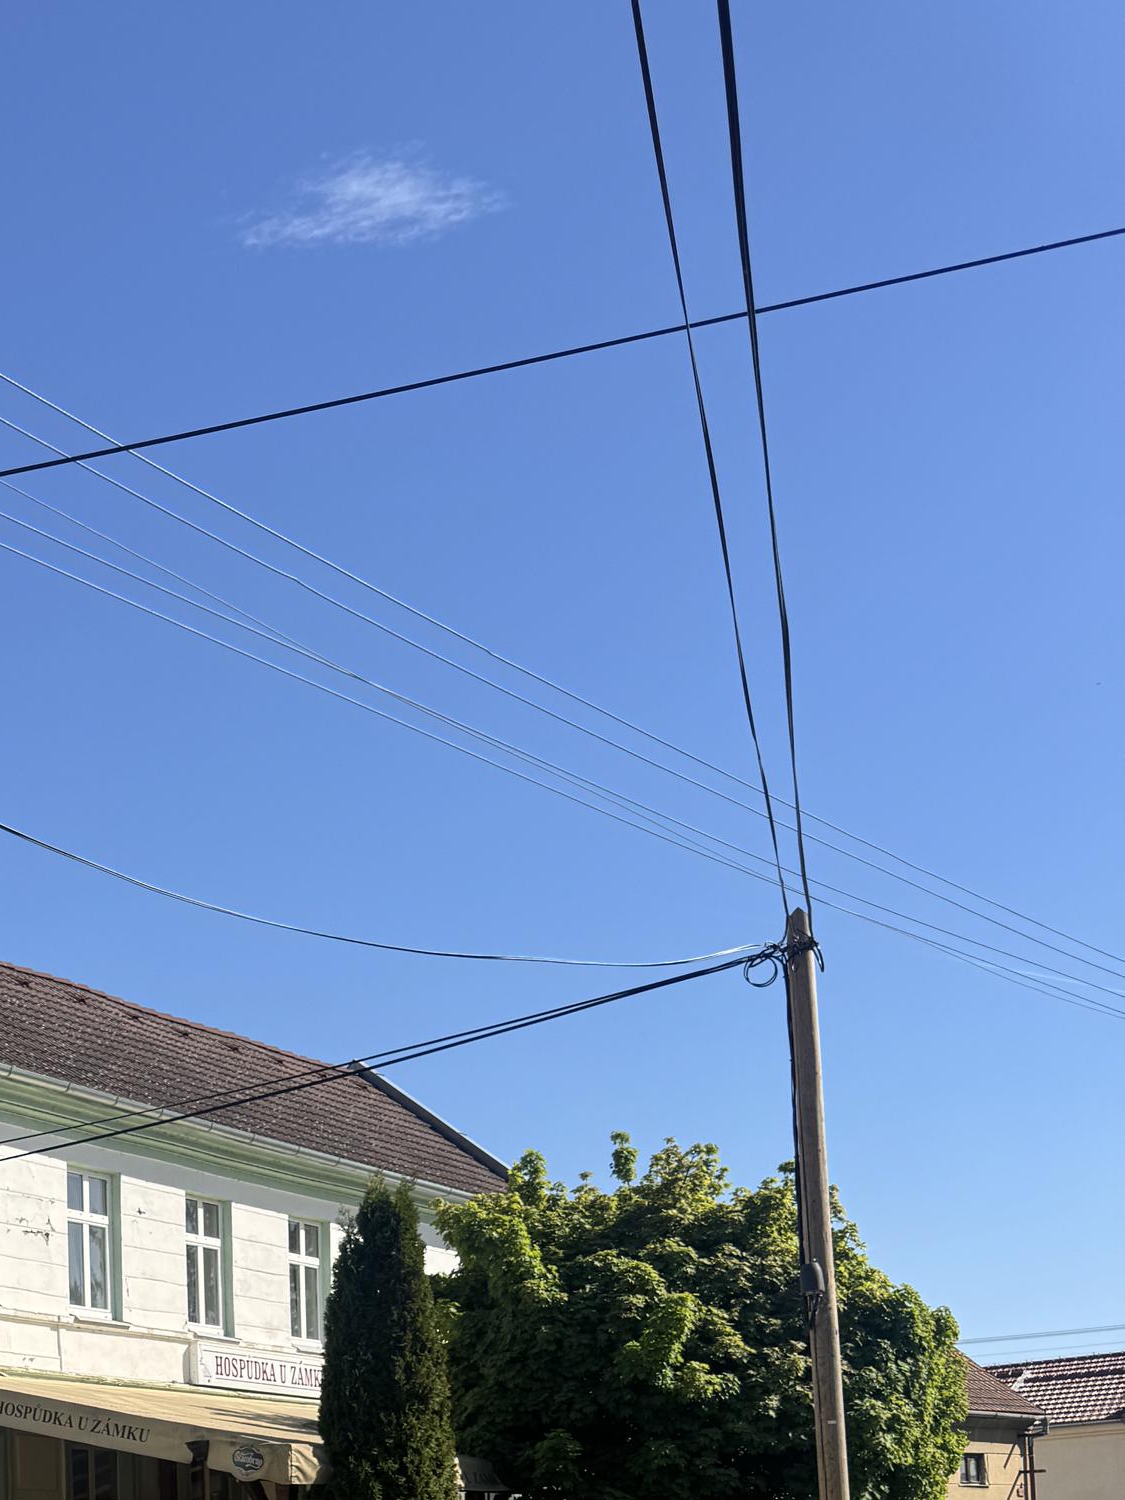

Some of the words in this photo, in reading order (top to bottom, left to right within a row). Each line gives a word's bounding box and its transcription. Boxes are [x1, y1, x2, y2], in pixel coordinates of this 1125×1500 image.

[279, 1364, 287, 1384] U
[291, 1360, 322, 1388] ZÁMK
[78, 1415, 89, 1431] U
[90, 1417, 151, 1443] ZÁMKU
